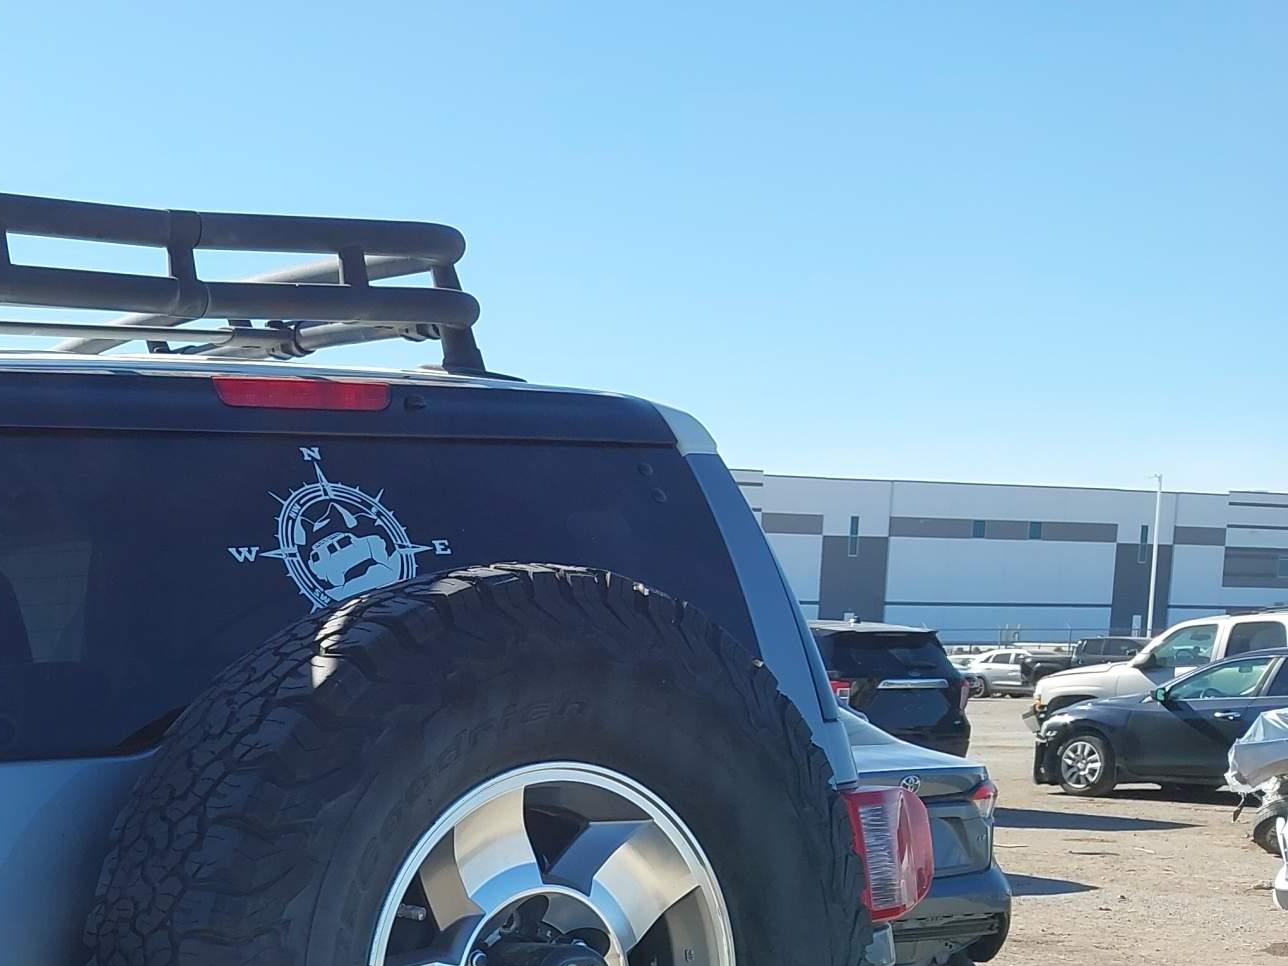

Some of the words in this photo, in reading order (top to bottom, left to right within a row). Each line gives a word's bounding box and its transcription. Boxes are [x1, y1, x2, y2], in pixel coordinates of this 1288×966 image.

[299, 446, 322, 462] N
[227, 546, 260, 563] W
[431, 539, 453, 555] E
